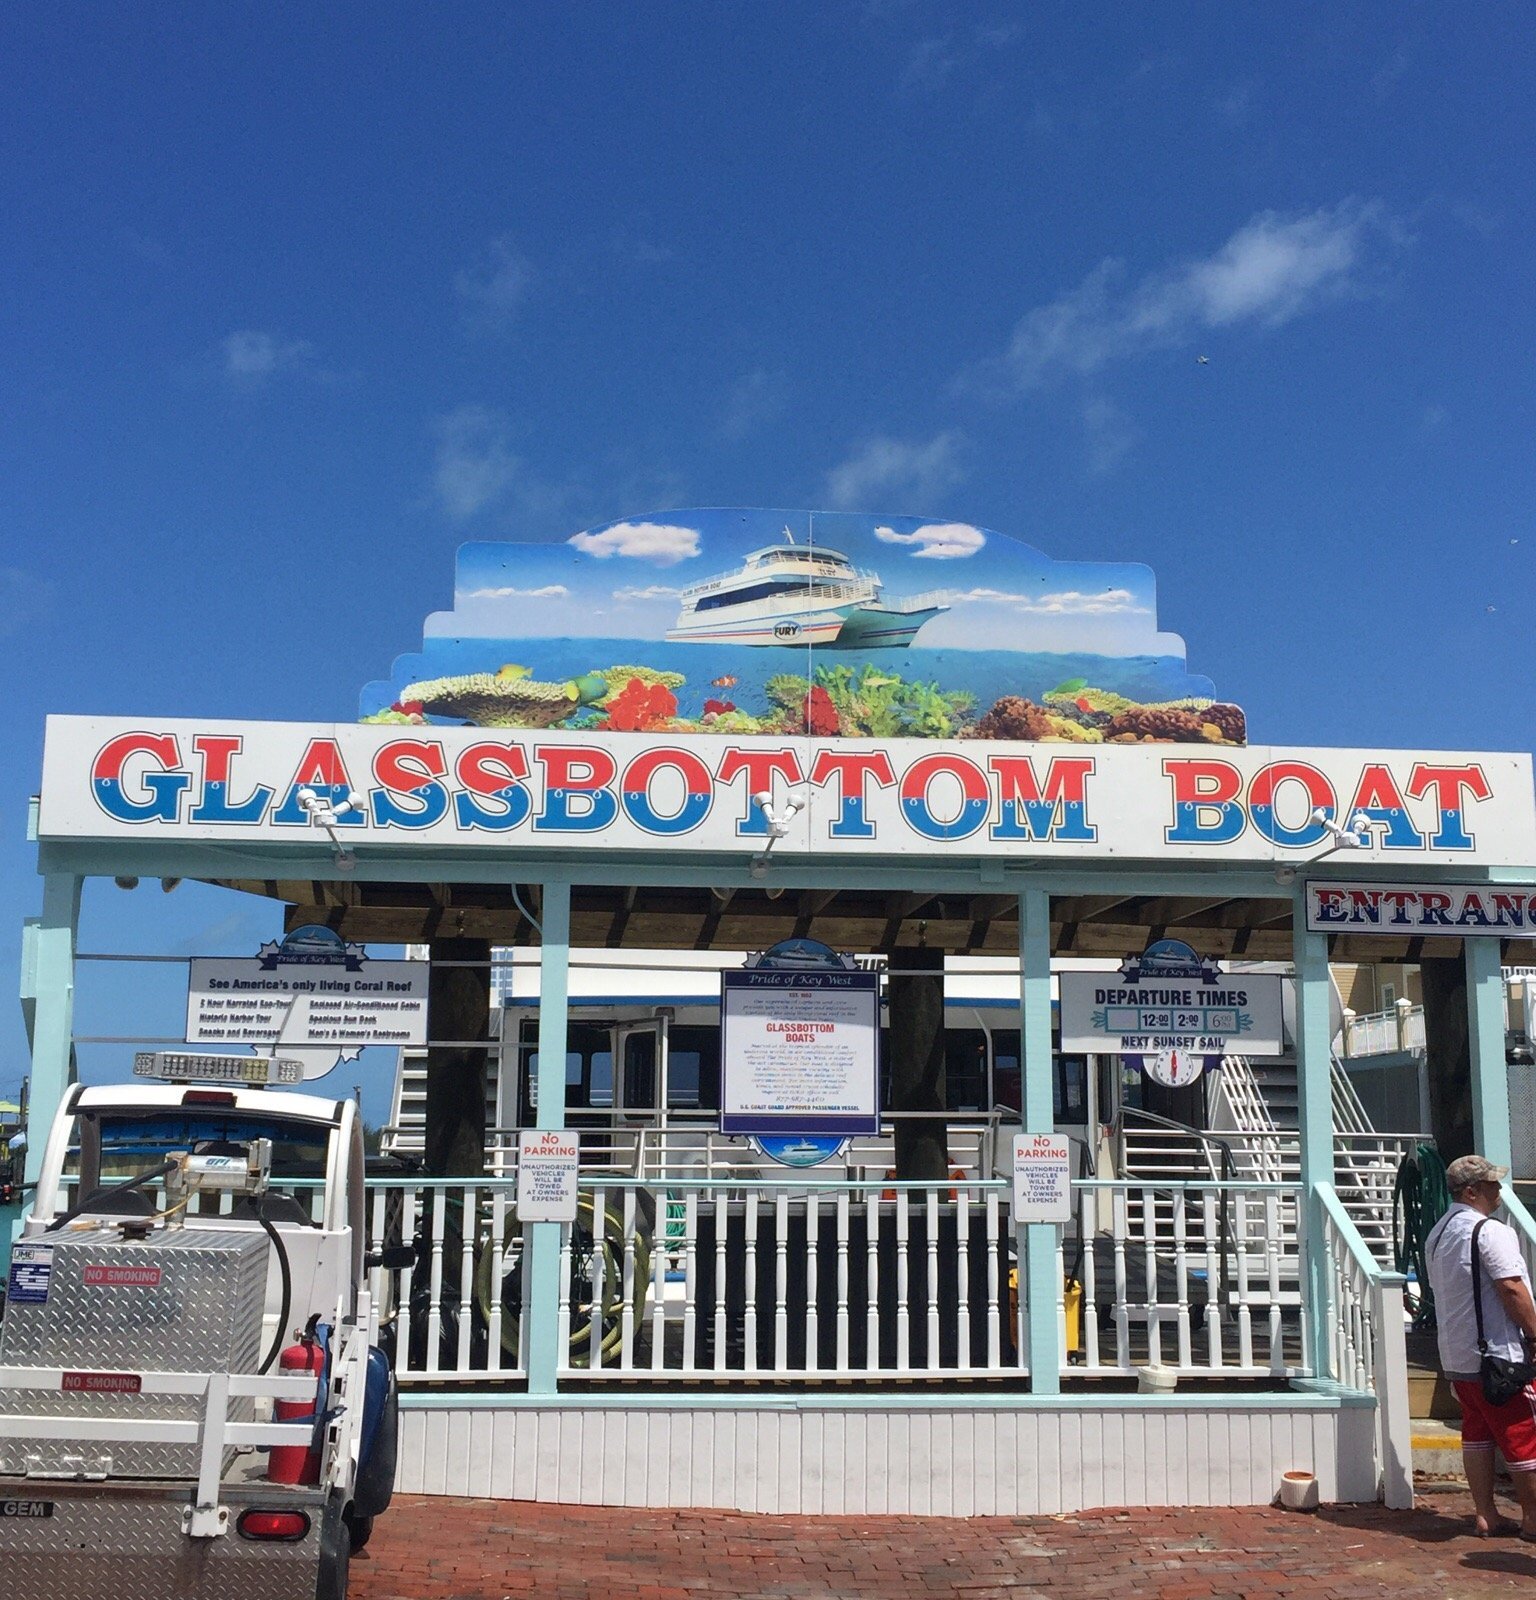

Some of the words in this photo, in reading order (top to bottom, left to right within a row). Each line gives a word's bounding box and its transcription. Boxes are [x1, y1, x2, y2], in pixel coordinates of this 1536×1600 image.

[773, 626, 799, 636] FURY
[91, 731, 1098, 843] GLASSBOTTOM
[1161, 758, 1494, 851] BOAT
[276, 954, 298, 964] Pride
[300, 954, 308, 964] of
[310, 955, 326, 965] Key
[328, 955, 346, 964] West
[1138, 968, 1160, 976] Pride
[1161, 968, 1168, 978] of
[1169, 968, 1184, 978] Key
[1186, 968, 1202, 976] West
[209, 978, 230, 990] See
[232, 978, 288, 990] America's
[292, 980, 316, 992] only
[320, 980, 351, 992] living
[354, 980, 383, 992] Coral
[386, 981, 412, 992] Reef
[749, 974, 781, 984] Pride
[784, 974, 796, 986] of
[798, 976, 822, 987] Key
[826, 974, 852, 985] West
[1095, 989, 1192, 1006] DEPARTURE
[1196, 990, 1248, 1006] TIMES
[207, 998, 224, 1008] Hour
[256, 1014, 272, 1022] Tour
[226, 1028, 241, 1036] and
[766, 1022, 834, 1033] GLASSBOTTOM
[786, 1034, 816, 1042] BOATS
[1122, 1036, 1150, 1048] NEXT
[1153, 1036, 1196, 1048] SUNSET
[1199, 1037, 1224, 1048] SAIL
[542, 1136, 559, 1144] NO
[1034, 1138, 1050, 1147] NO
[524, 1146, 576, 1156] PARKING
[1017, 1149, 1067, 1158] PARKING
[86, 1269, 104, 1282] NO
[106, 1270, 158, 1283] SMOKING
[64, 1376, 82, 1389] NO
[86, 1377, 138, 1390] SMOKING
[4, 1502, 45, 1516] GEM
